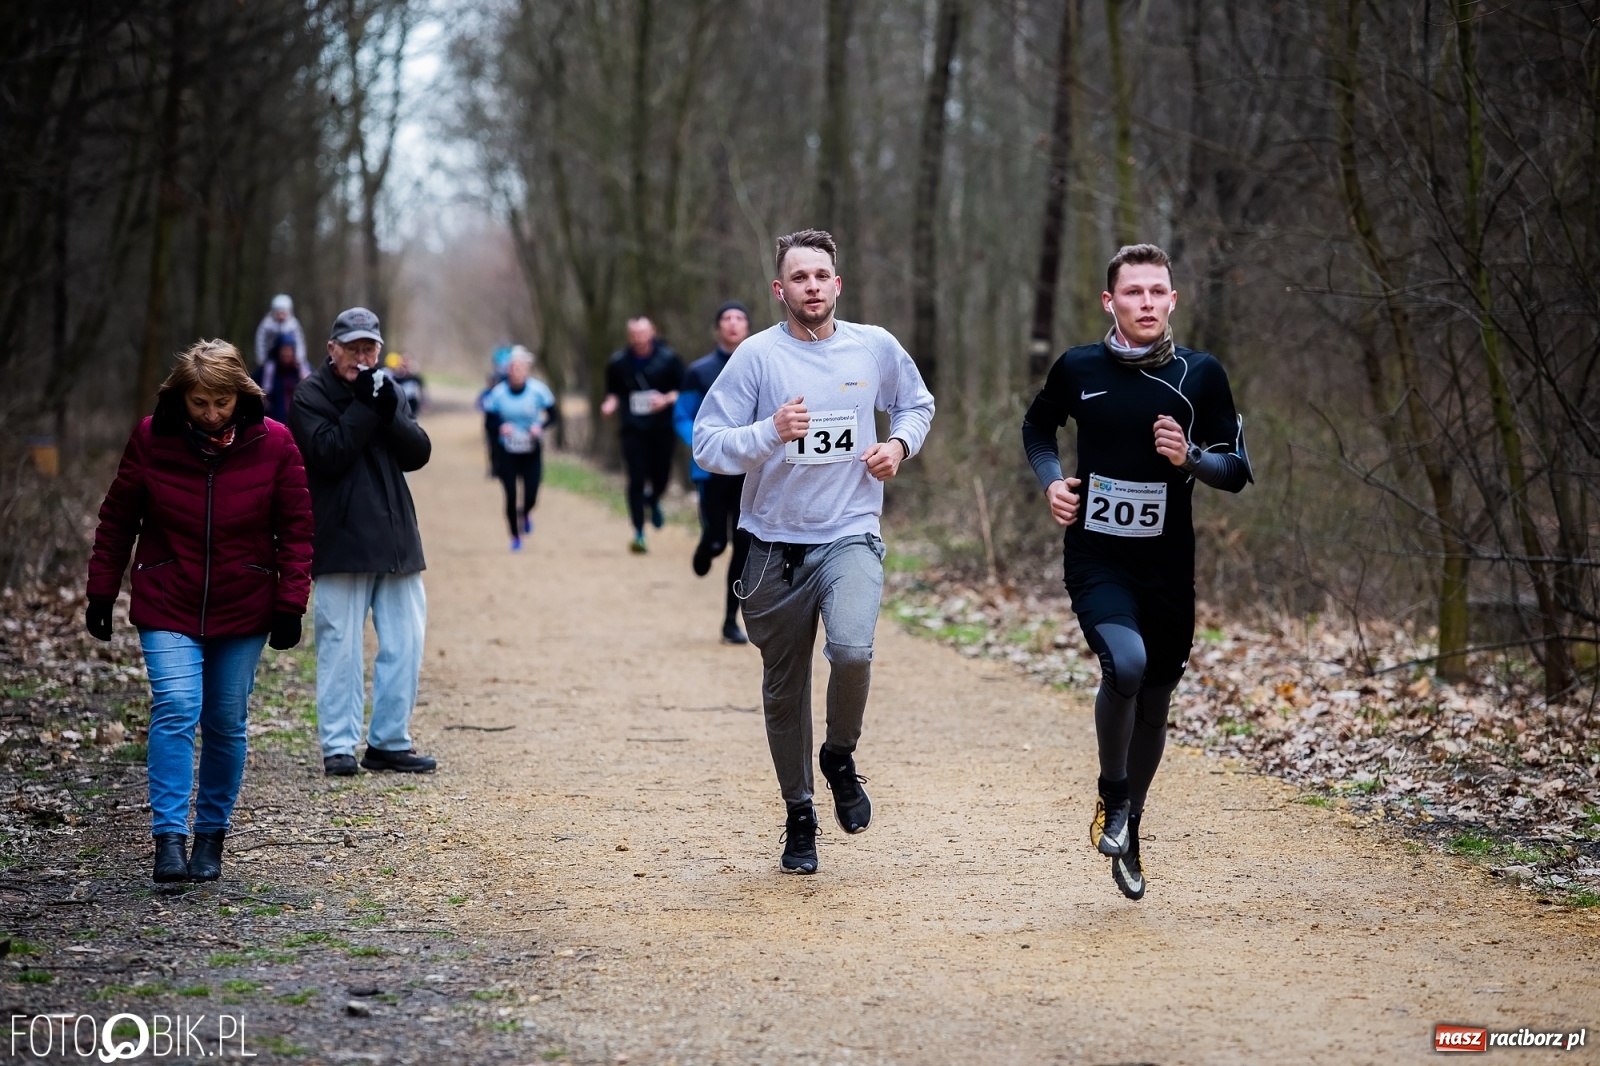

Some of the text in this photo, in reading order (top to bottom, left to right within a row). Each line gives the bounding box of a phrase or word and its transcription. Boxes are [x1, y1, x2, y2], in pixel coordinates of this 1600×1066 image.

[791, 429, 854, 454] 134
[1115, 487, 1163, 495] www.personalbest.pl
[1090, 496, 1160, 527] 205
